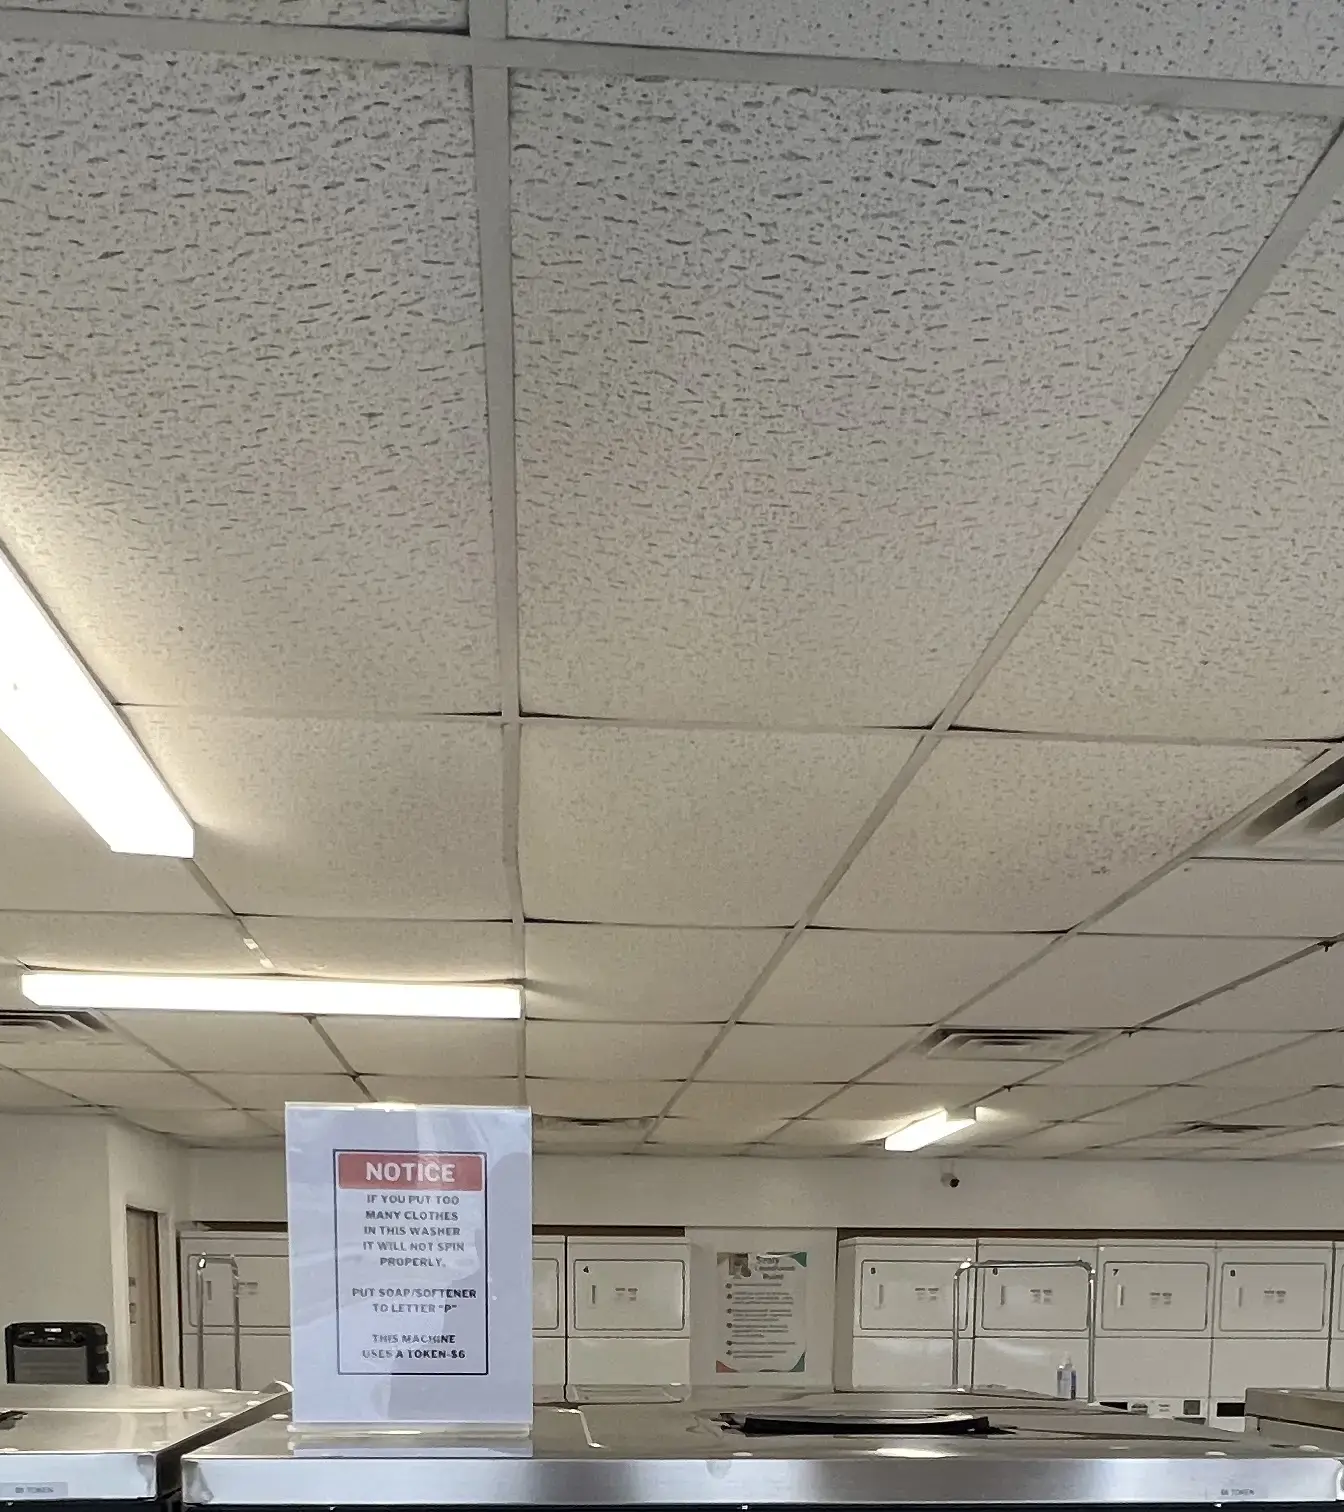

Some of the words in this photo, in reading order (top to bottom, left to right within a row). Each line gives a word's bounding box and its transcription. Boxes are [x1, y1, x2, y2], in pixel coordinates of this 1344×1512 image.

[365, 1161, 456, 1183] NOTICE
[366, 1194, 378, 1204] IF
[381, 1194, 405, 1204] YOU
[408, 1195, 431, 1204] PUT
[436, 1195, 460, 1205] TOO
[365, 1210, 400, 1220] MANY
[404, 1211, 458, 1221] CLOTHES
[363, 1226, 376, 1235] IN
[379, 1226, 406, 1235] THIS
[409, 1226, 461, 1236] WASHER
[362, 1241, 374, 1250] IT
[377, 1241, 406, 1251] WILL
[409, 1242, 433, 1251] NOT
[437, 1242, 464, 1252] SPIN
[379, 1257, 446, 1267] PROPERLY.
[352, 1287, 375, 1297] PUT
[378, 1288, 477, 1298] SOAP/SOFTENER
[373, 1303, 388, 1312] TO
[391, 1304, 435, 1313] LETTER
[371, 1334, 399, 1343] THIS
[402, 1334, 456, 1344] MACHINE
[362, 1350, 393, 1359] USES
[395, 1350, 404, 1359] A
